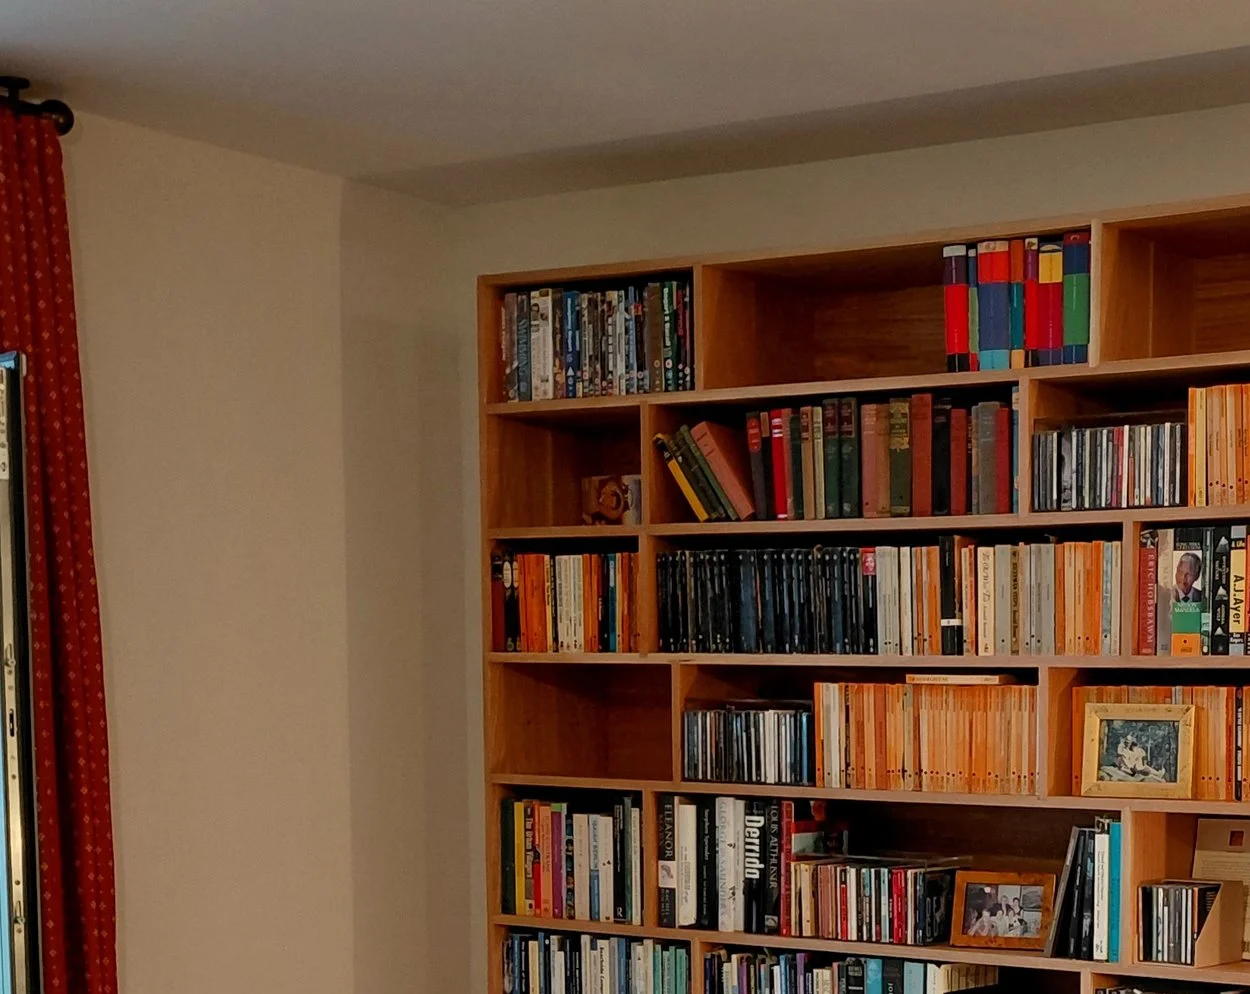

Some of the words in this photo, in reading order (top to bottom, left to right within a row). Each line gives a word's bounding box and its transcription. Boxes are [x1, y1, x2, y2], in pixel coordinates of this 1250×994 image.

[519, 319, 527, 375] SWIMMING
[664, 804, 673, 858] ELEANOR
[744, 815, 764, 879] Derrida
